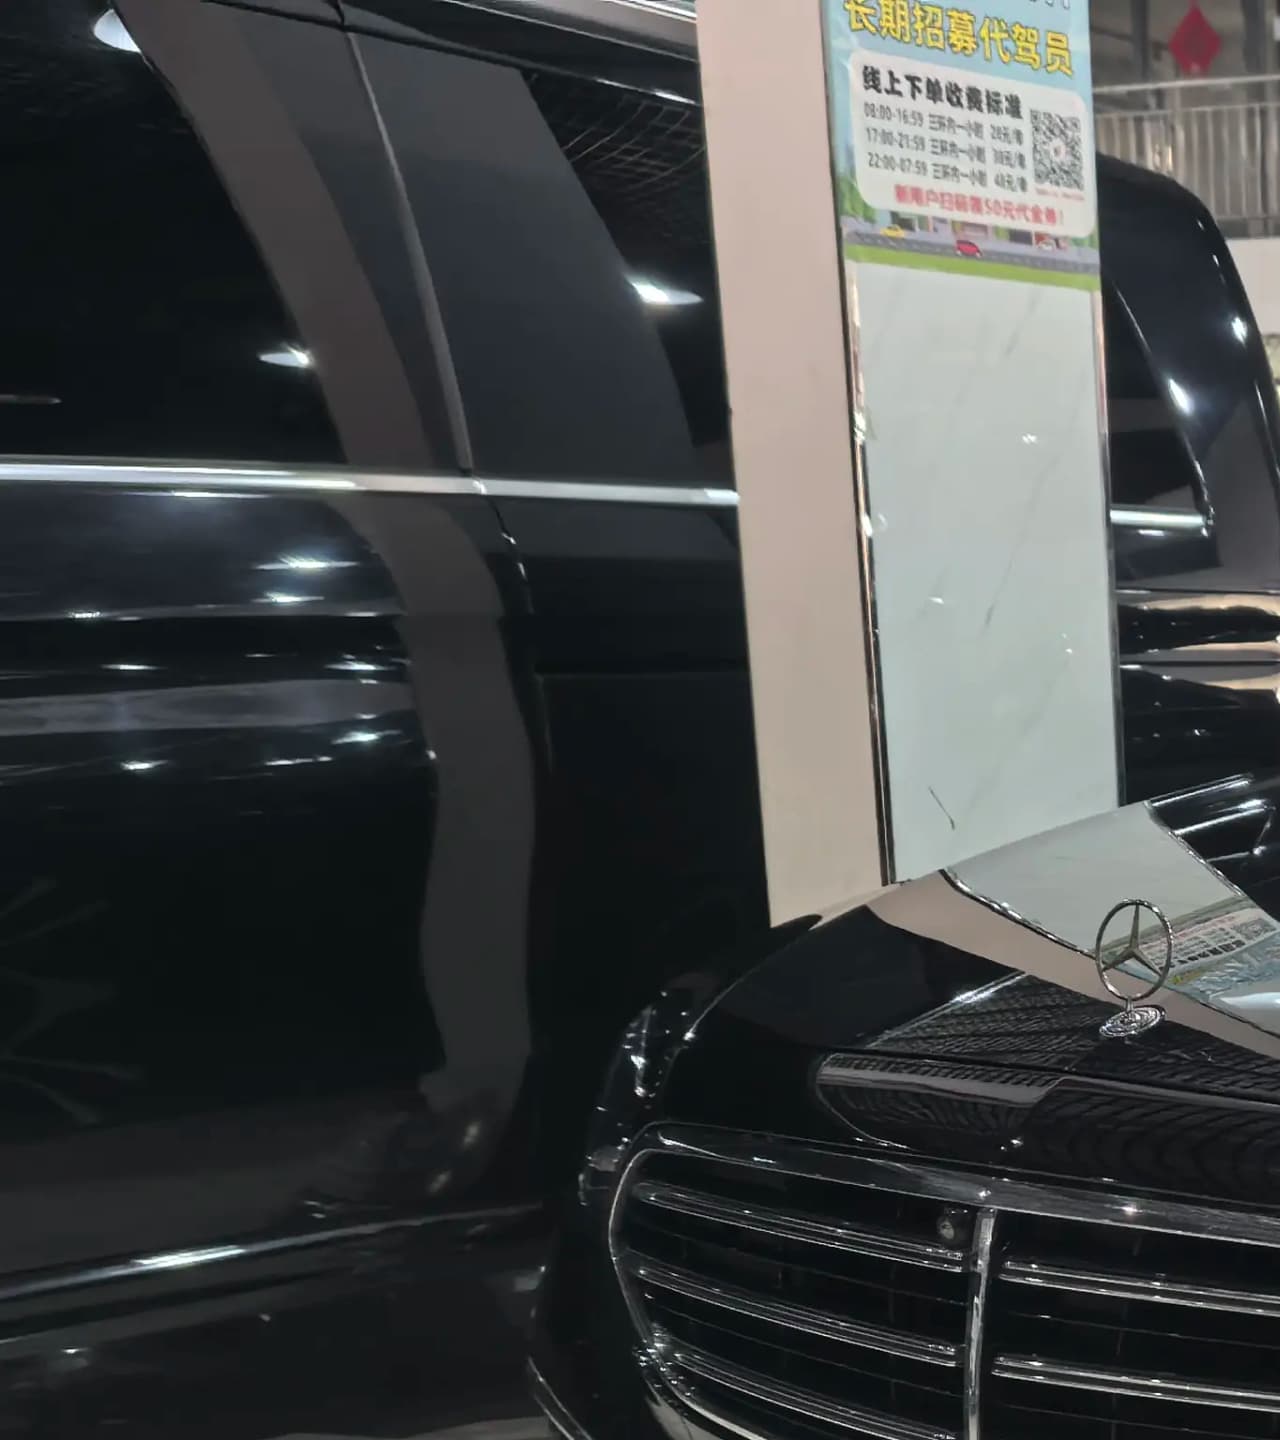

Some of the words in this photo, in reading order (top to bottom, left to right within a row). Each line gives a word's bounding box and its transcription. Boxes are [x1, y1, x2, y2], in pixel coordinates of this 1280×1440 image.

[845, 0, 1074, 76] 长期招募代驾员
[862, 65, 1023, 119] 线上下单收费标准
